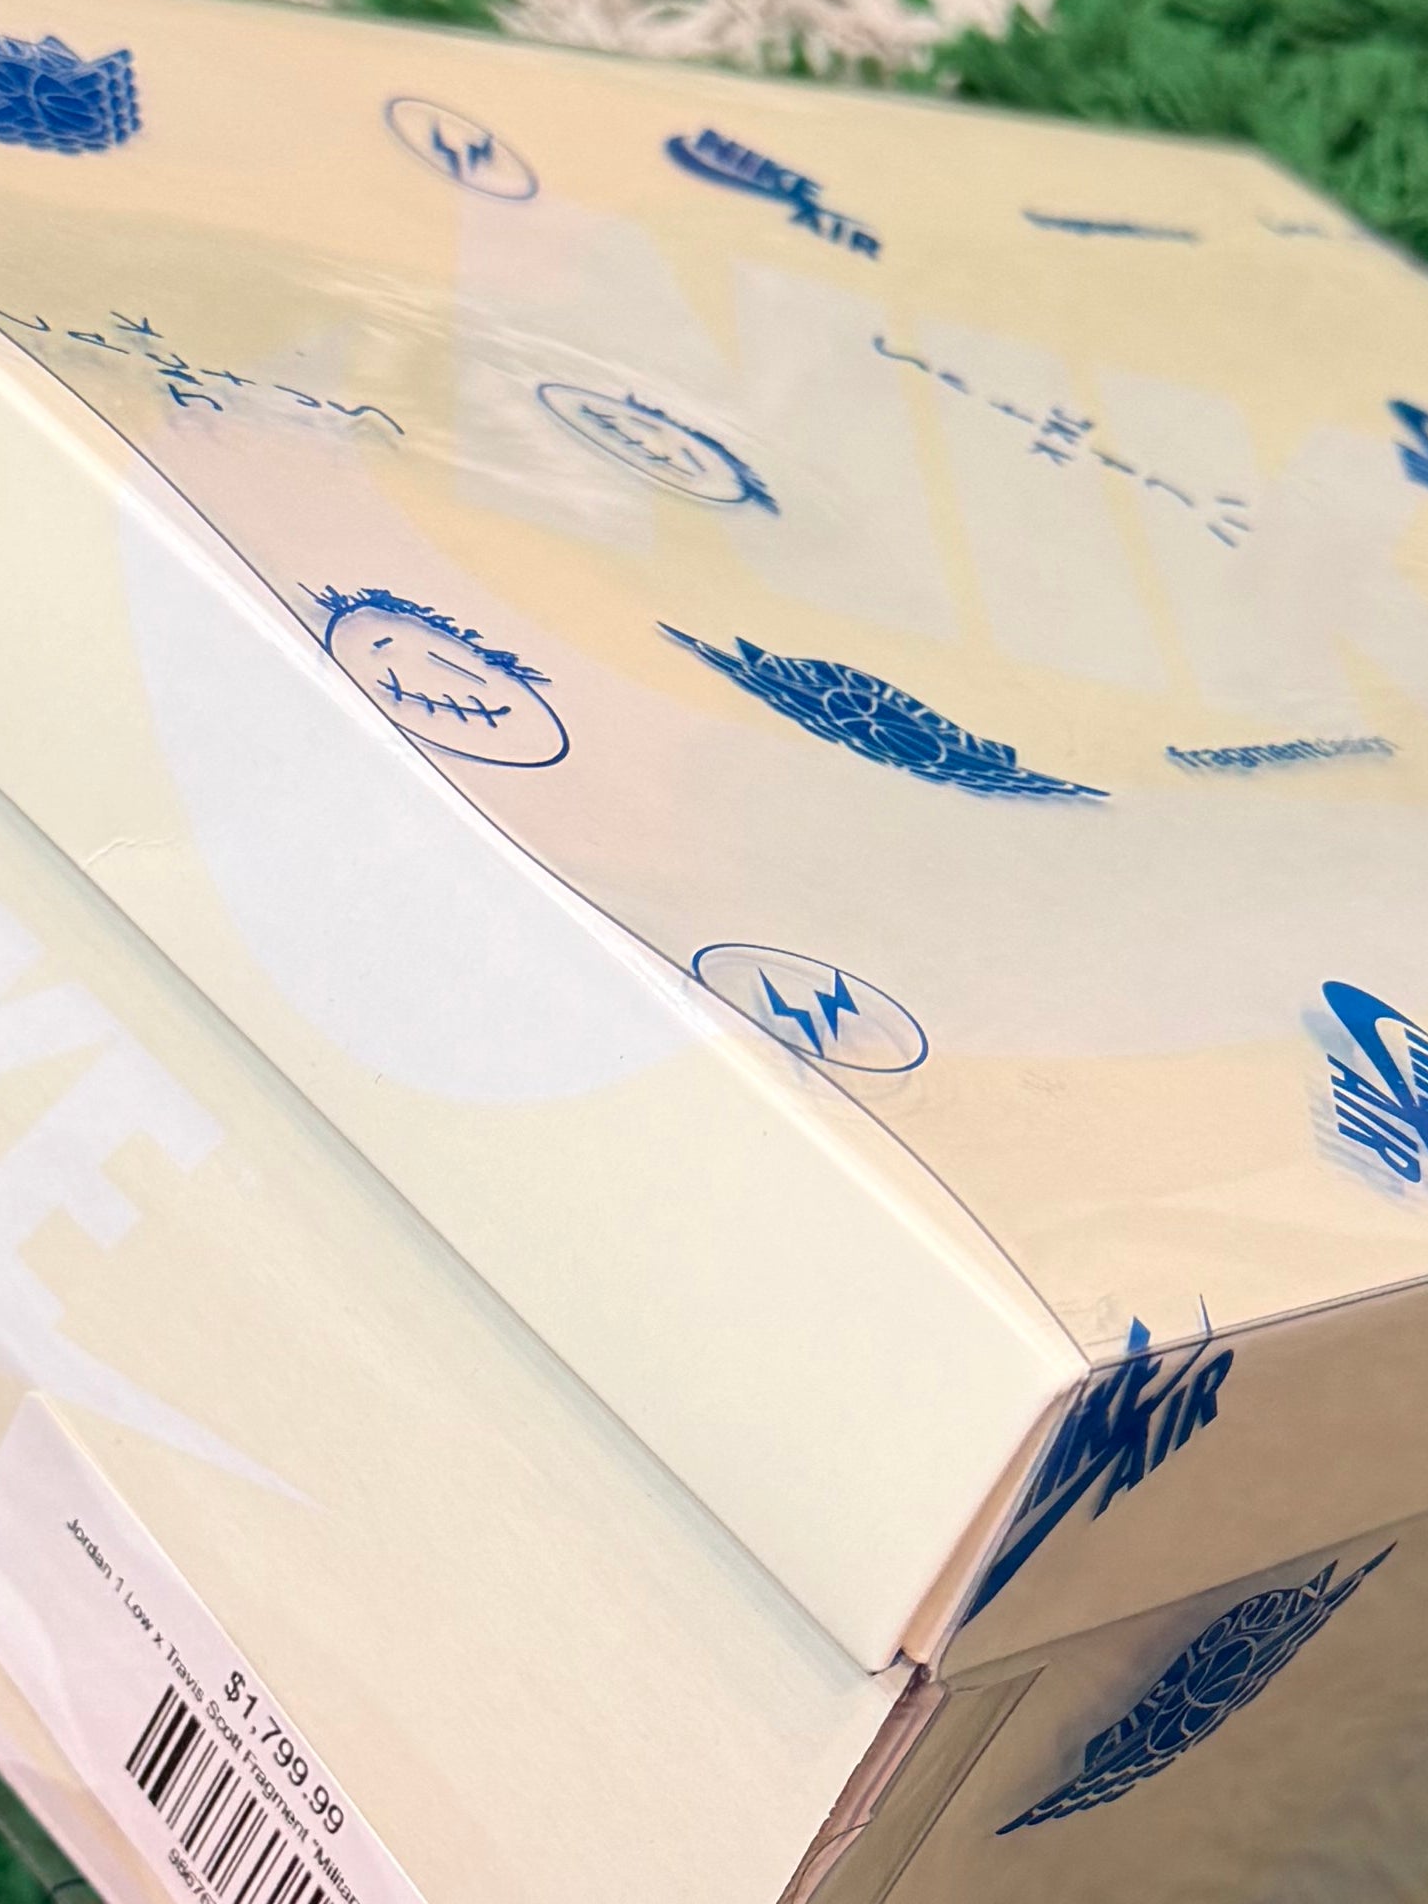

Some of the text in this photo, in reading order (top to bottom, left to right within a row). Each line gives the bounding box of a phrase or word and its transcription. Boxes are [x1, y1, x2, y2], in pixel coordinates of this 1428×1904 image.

[755, 653, 1012, 768] AIR JORDAN
[1327, 1053, 1421, 1183] AIR
[1091, 1349, 1234, 1521] AIR
[67, 1519, 112, 1579] Jordan
[115, 1577, 124, 1592] 1
[124, 1591, 153, 1631] Low
[152, 1632, 164, 1648] x
[166, 1643, 204, 1702] Travis
[206, 1700, 243, 1752] Scott
[243, 1749, 309, 1842] Fragment
[1095, 1572, 1326, 1761] AIR JORDAN
[224, 1670, 345, 1835] $1,799.99
